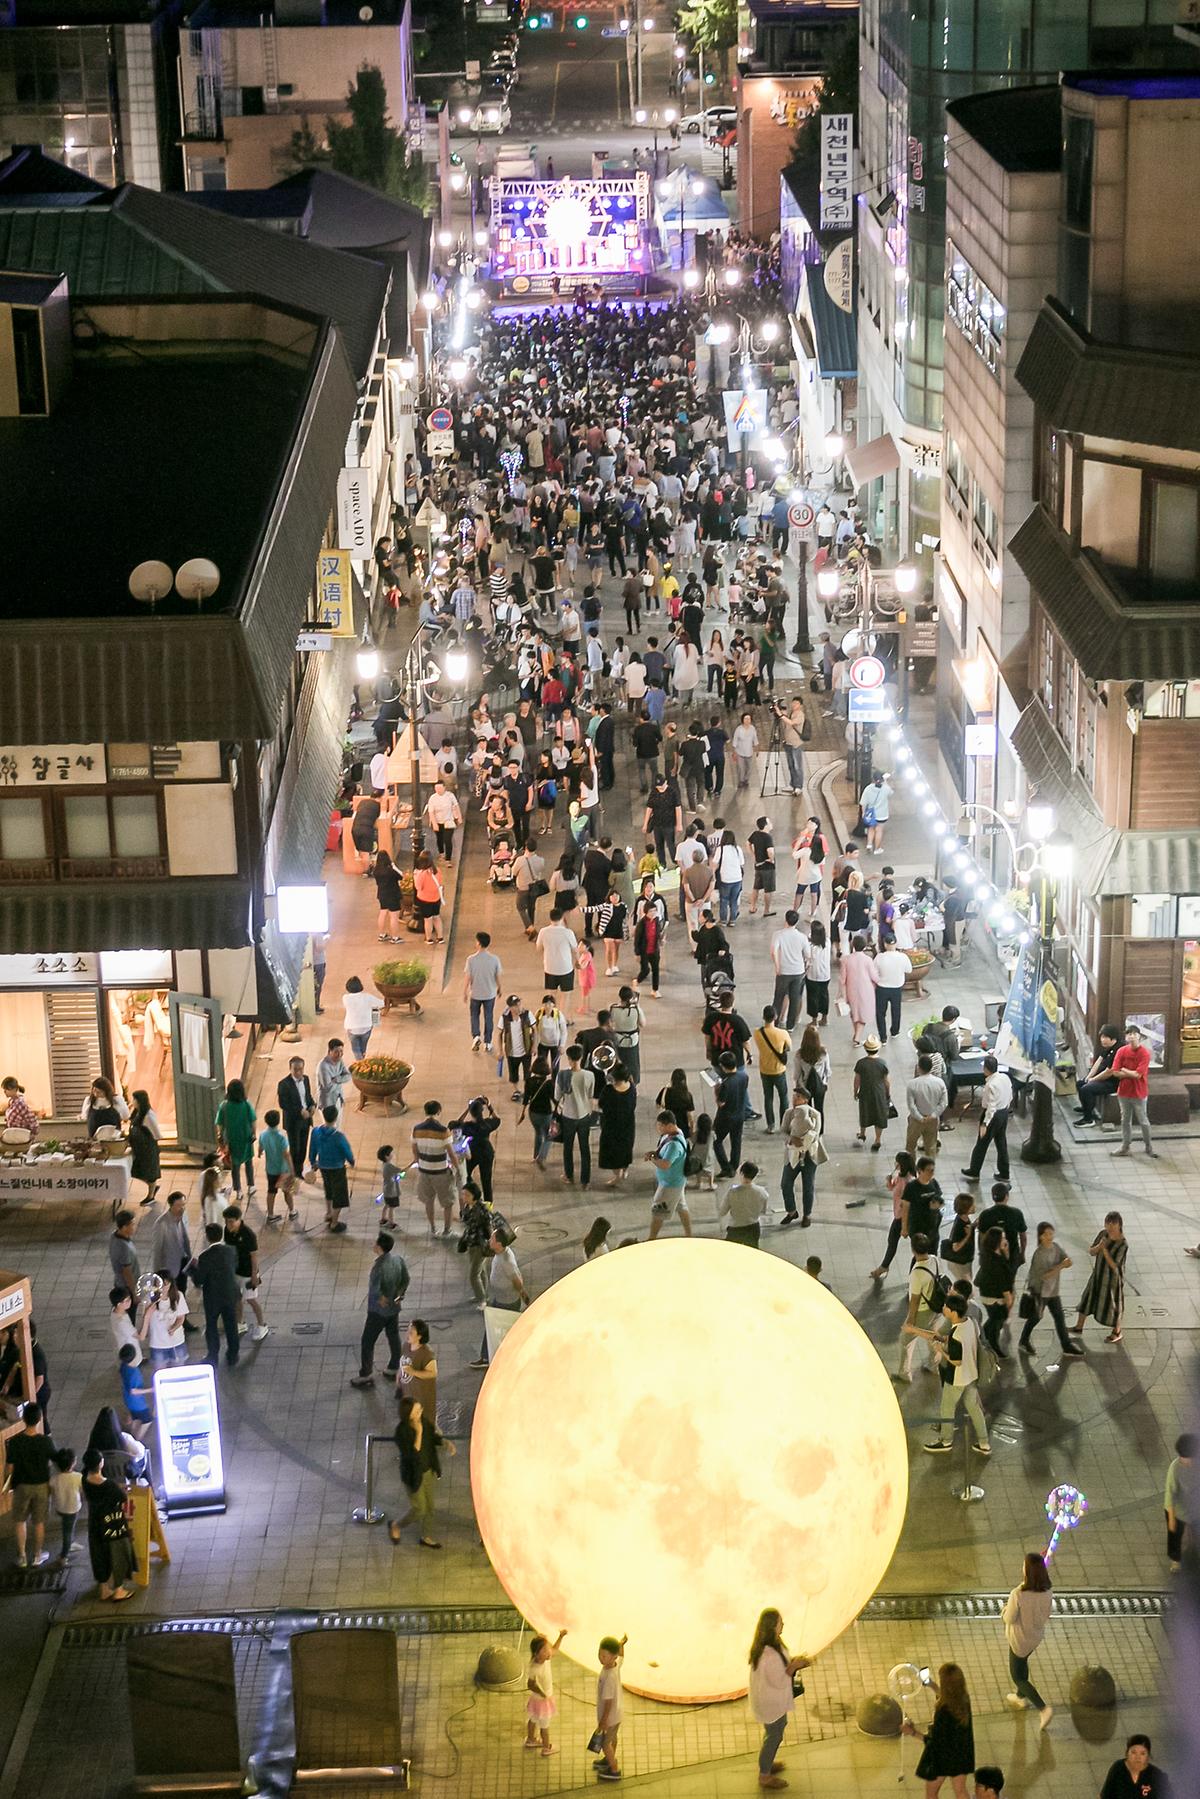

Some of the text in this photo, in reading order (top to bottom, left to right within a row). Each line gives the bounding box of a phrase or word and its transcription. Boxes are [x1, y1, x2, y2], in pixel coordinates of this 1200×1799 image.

[793, 509, 809, 520] 30
[322, 557, 342, 627] 汉语村
[31, 755, 94, 781] 참글사
[37, 956, 88, 973] 소소소
[711, 1020, 734, 1049] NY
